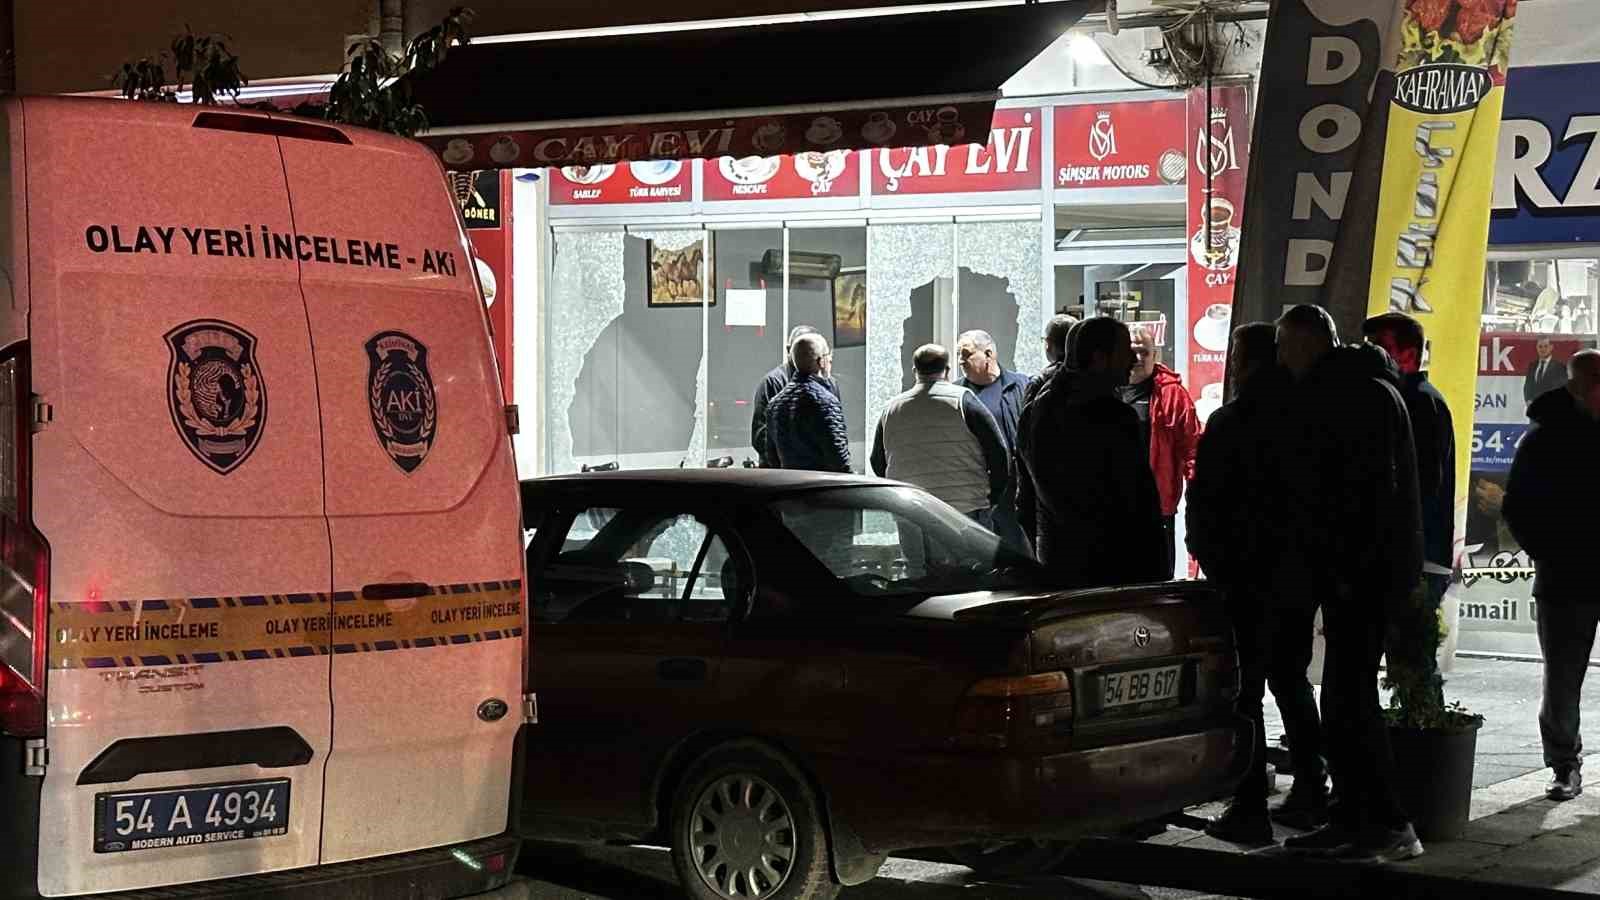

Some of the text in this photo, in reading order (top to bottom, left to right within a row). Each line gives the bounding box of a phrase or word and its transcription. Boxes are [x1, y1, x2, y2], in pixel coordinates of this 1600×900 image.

[1058, 164, 1149, 185] ŞİMŞEK MOTORS
[1283, 36, 1361, 316] DOND
[464, 207, 495, 221] DÖNER
[86, 225, 174, 254] OLAY
[184, 224, 255, 258] YERİ
[262, 225, 400, 269] İNCELEME
[423, 250, 457, 277] AKİ
[1205, 273, 1231, 288] ÇAY
[266, 612, 393, 635] OLAY YERİ İNCELEME
[431, 601, 521, 624] OLAY YERİ İNCELEME
[104, 621, 140, 642] YERİ
[145, 620, 219, 640] İNCELEME
[1105, 669, 1177, 703] 54 BB 617
[115, 788, 276, 836] 54 A 4934
[131, 837, 174, 849] MODERN
[176, 835, 202, 845] AUTO
[204, 830, 245, 842] SERVICE
